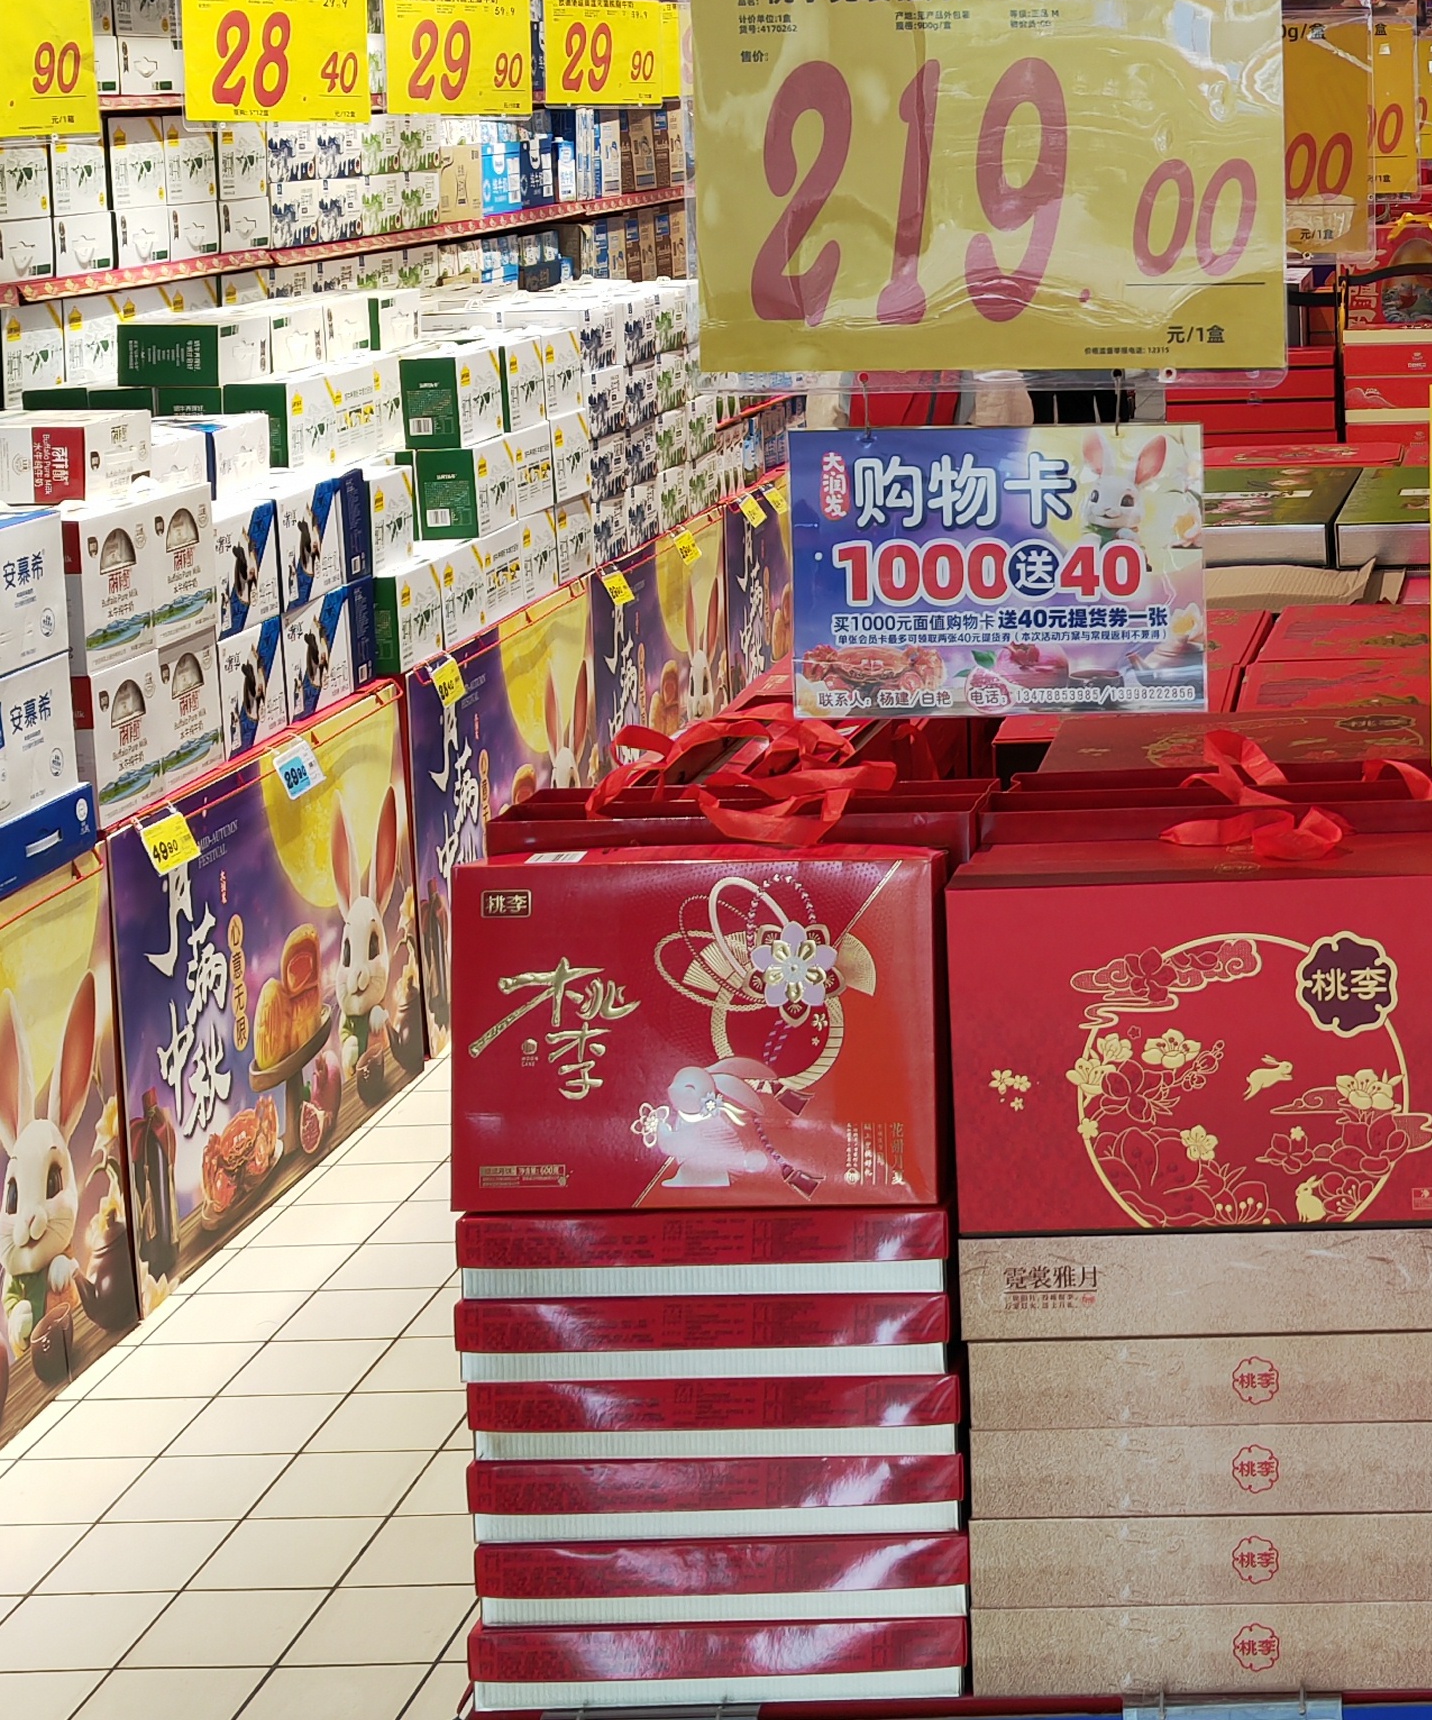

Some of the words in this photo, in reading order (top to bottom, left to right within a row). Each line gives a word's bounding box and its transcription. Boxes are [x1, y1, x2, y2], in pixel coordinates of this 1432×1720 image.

[738, 23, 798, 34] 货号:4170262
[740, 49, 770, 63] 售价:
[1166, 324, 1226, 345] 元/1盒
[823, 452, 847, 518] 大润发
[853, 452, 1075, 528] 购物卡
[2, 551, 43, 591] 安慕希
[833, 613, 996, 634] 买1000元面值购物卡
[998, 606, 1169, 630] 送40元提货券一张
[9, 691, 52, 736] 安慕希
[486, 893, 528, 915] 桃李
[1311, 967, 1388, 1002] 桃李
[1003, 1264, 1098, 1290] 霓裳雅月
[1238, 1372, 1276, 1390] 桃李
[1238, 1460, 1276, 1479] 桃李
[1238, 1551, 1276, 1570] 桃李
[1239, 1639, 1277, 1657] 桃李
